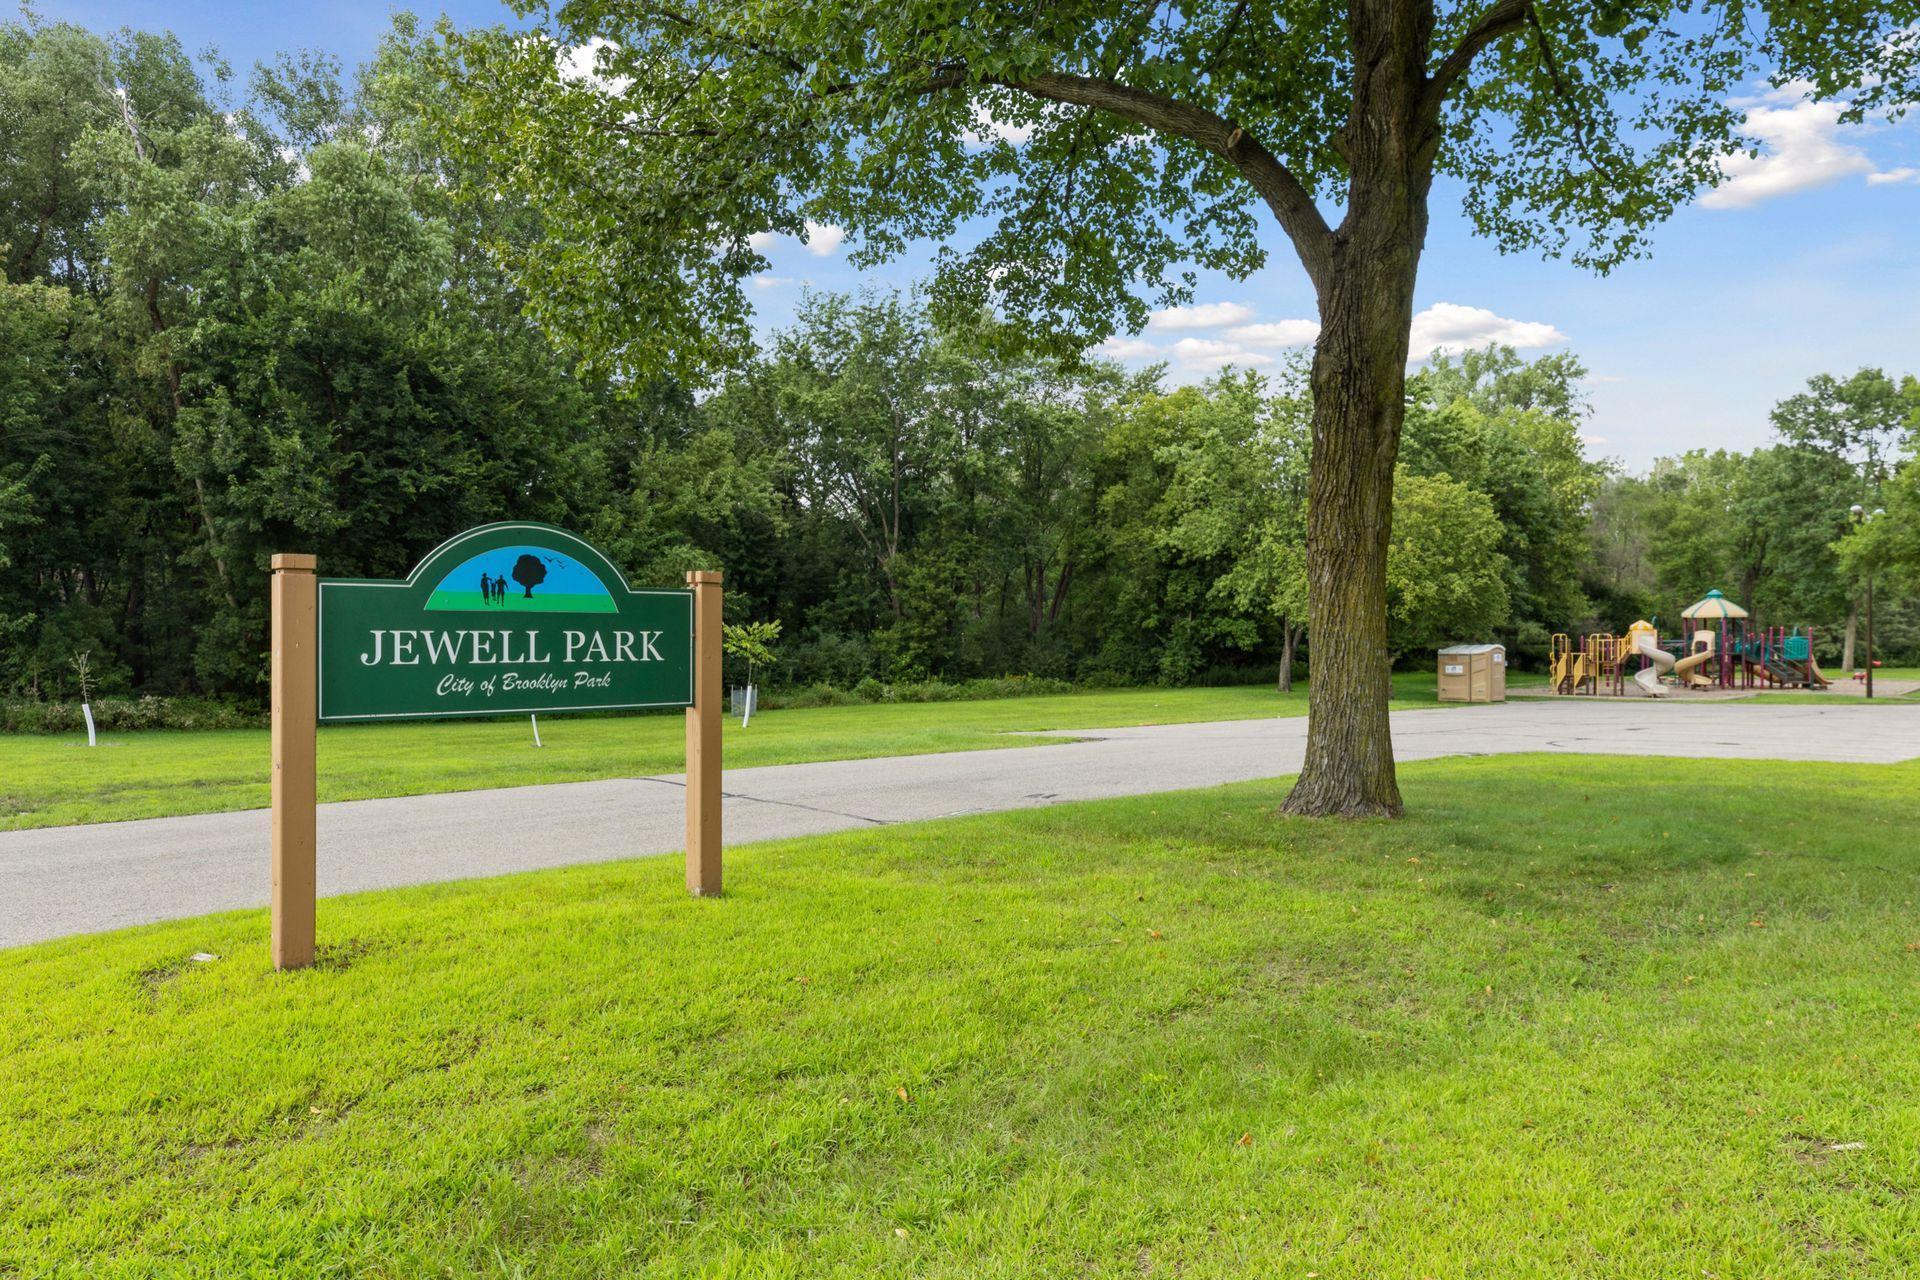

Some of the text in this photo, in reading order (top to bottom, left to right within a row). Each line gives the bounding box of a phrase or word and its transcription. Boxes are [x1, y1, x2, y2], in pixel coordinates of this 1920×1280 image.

[360, 630, 664, 665] JEWELL PARK
[436, 671, 611, 696] City of Brooklyn Park
